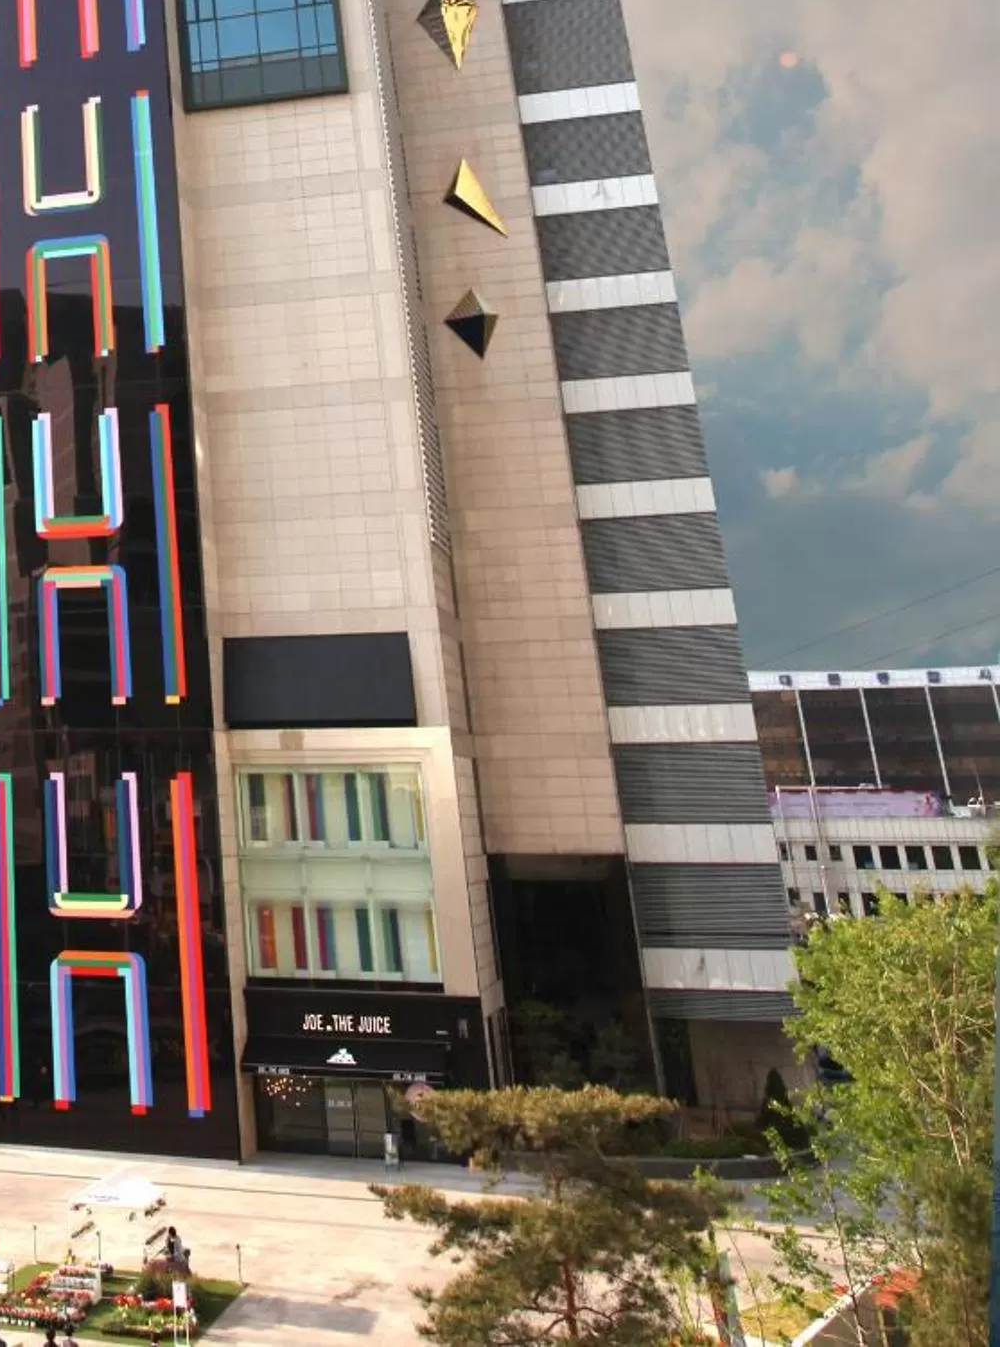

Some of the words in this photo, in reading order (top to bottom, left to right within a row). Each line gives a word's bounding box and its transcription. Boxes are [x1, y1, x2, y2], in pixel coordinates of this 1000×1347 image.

[303, 1013, 324, 1031] JOE
[332, 1014, 354, 1032] THE
[359, 1016, 392, 1034] JUICE
